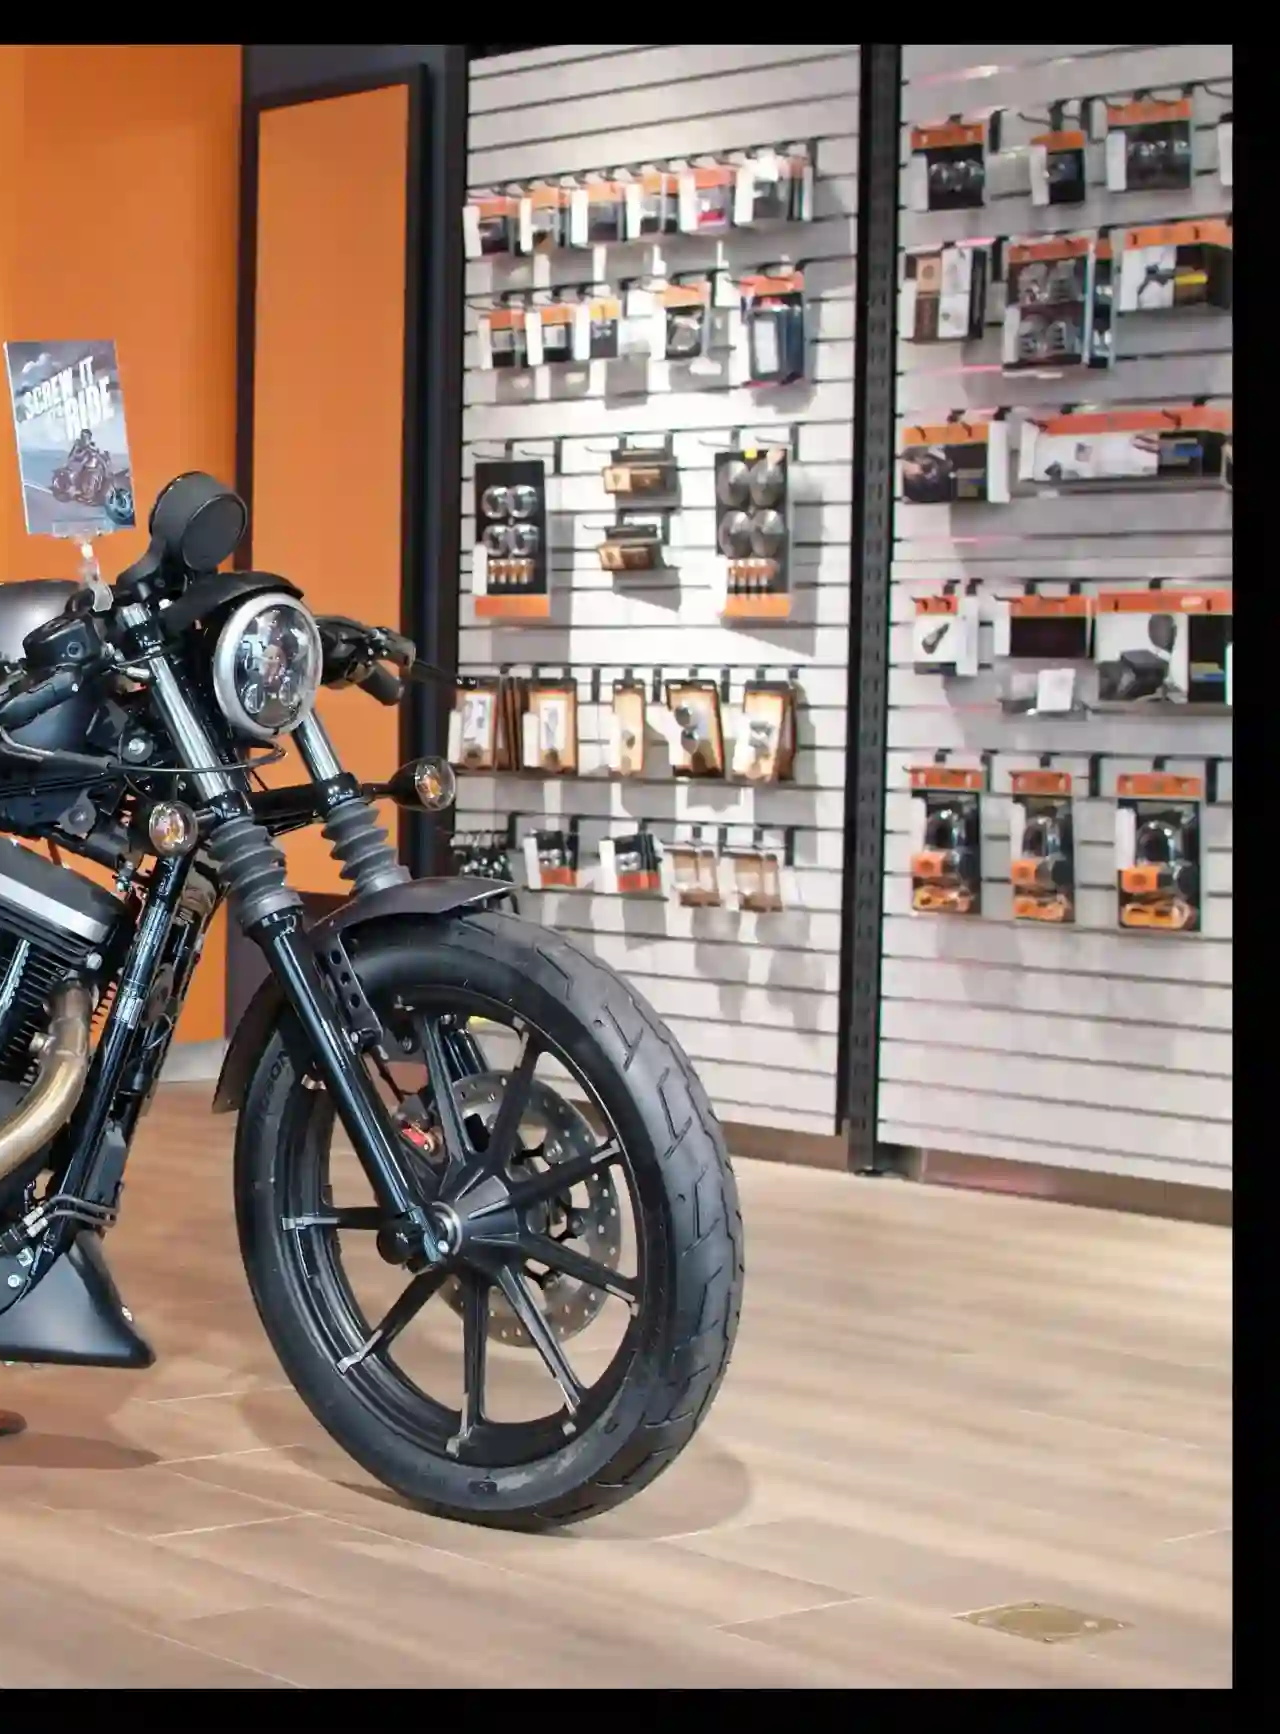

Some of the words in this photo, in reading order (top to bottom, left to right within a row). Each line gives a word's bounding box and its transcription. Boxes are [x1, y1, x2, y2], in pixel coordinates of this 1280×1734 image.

[23, 366, 73, 420] SCREW
[78, 355, 93, 390] IT
[64, 375, 115, 441] RIDE
